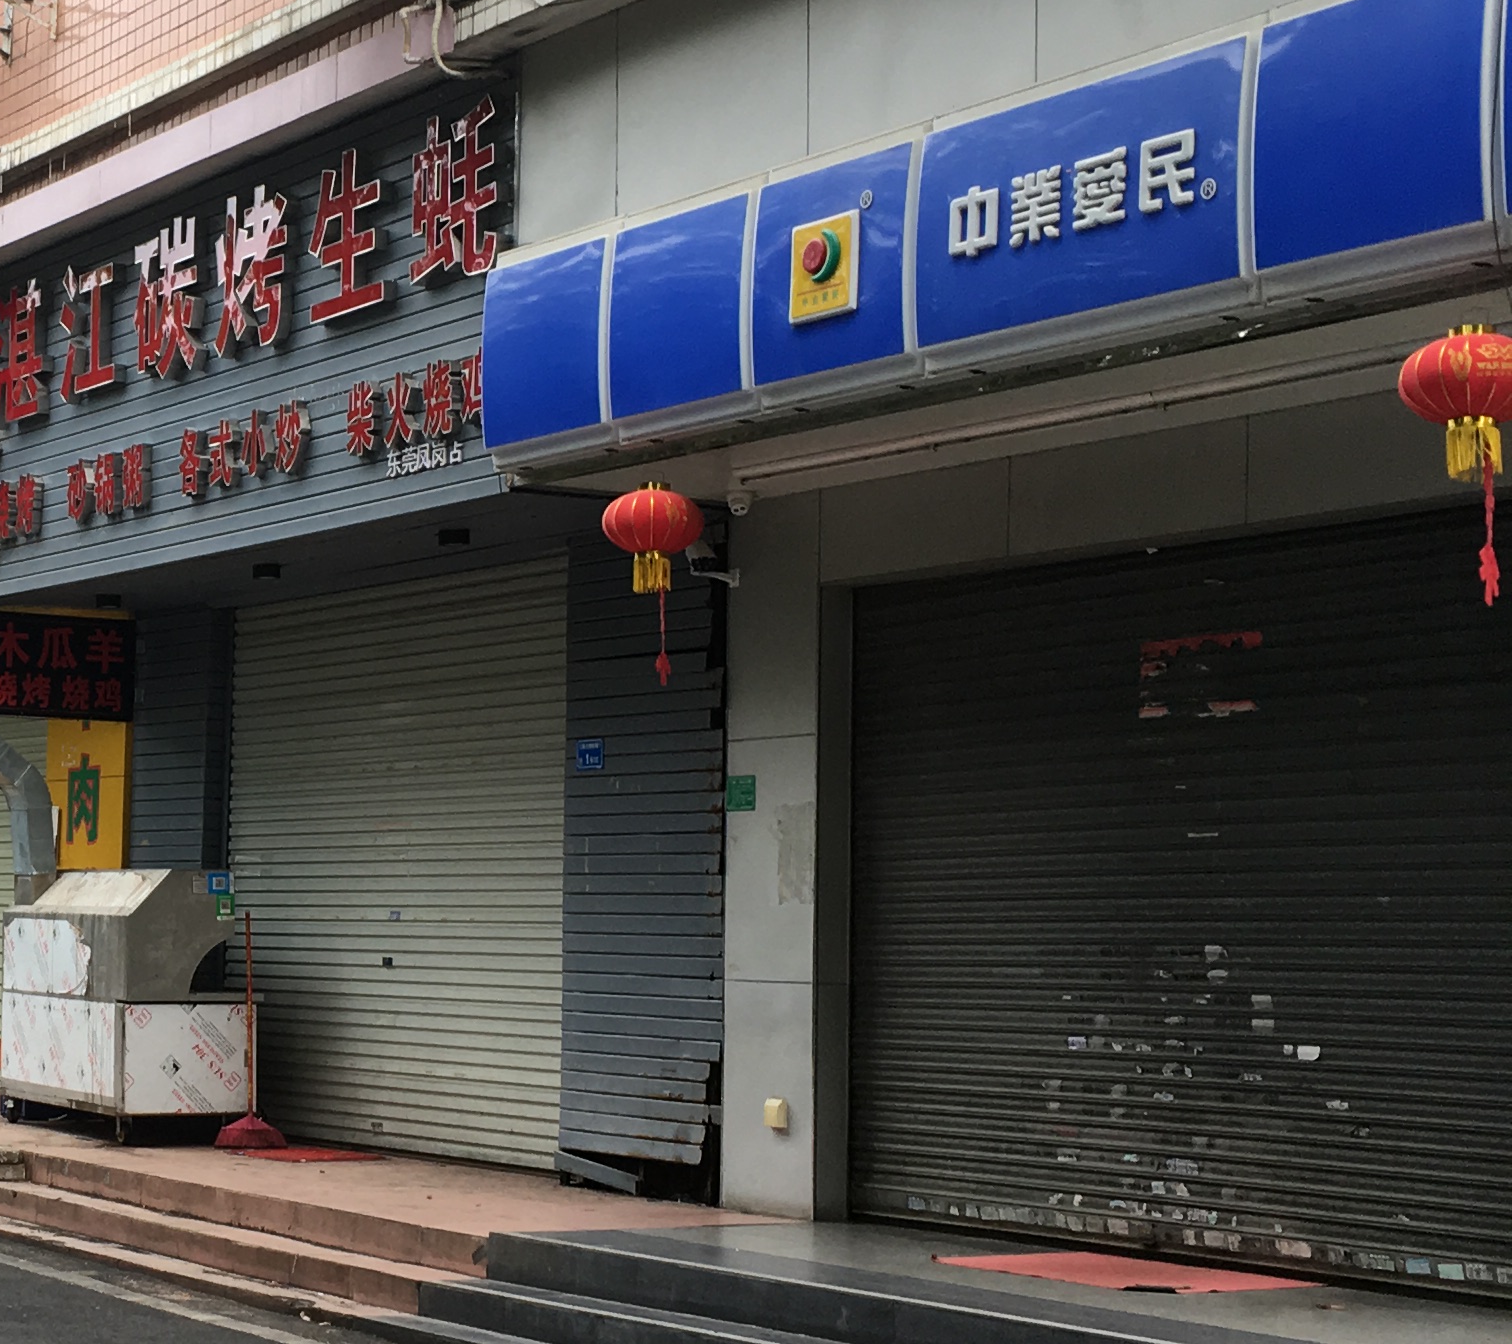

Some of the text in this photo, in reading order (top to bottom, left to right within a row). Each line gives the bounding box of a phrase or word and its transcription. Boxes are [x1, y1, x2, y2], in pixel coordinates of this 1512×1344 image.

[66, 443, 145, 521] 砂锅粥
[178, 400, 306, 497] 各式小炒
[61, 675, 123, 713] 烧鸡
